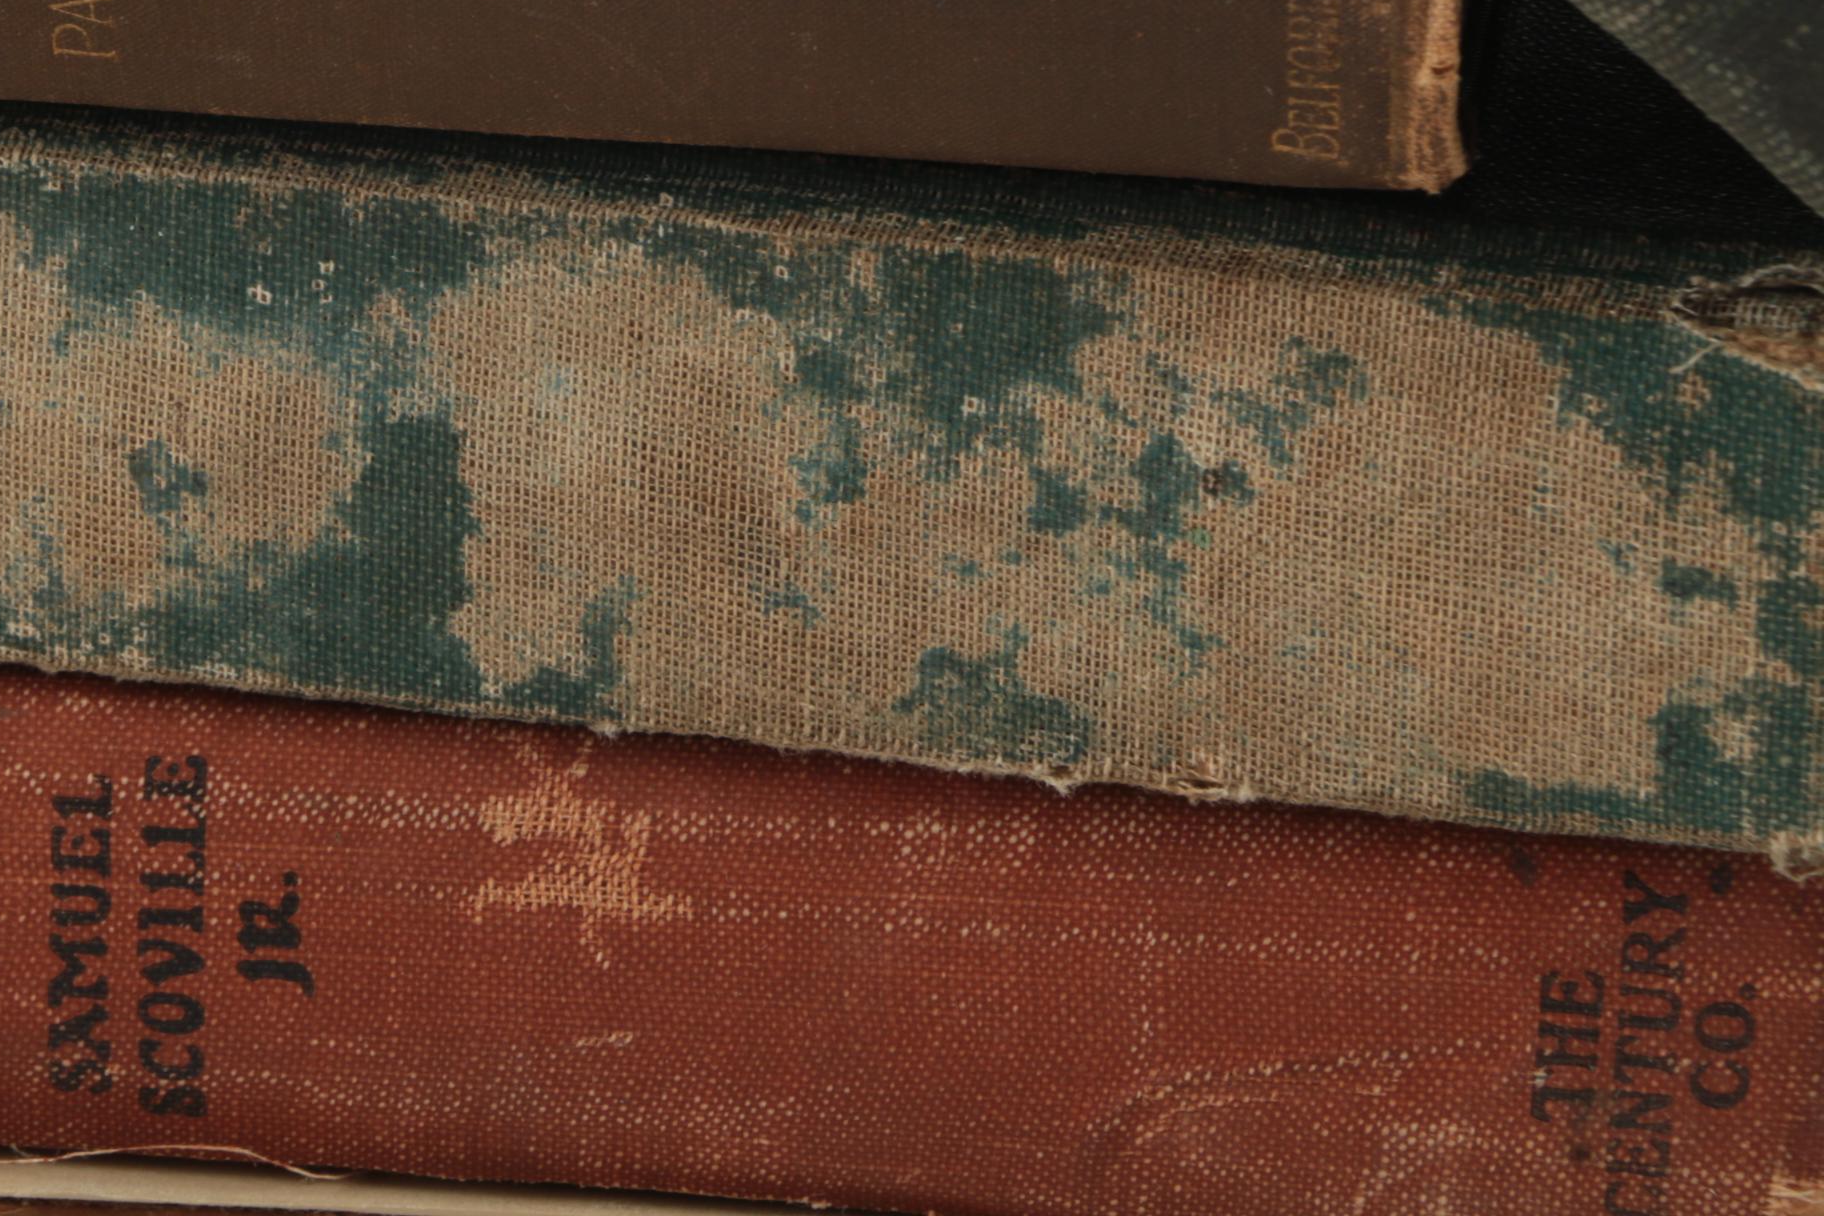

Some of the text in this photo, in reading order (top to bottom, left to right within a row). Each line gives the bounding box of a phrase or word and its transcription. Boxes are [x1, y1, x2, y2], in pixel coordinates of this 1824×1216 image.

[47, 773, 113, 1095] SAMUEL
[136, 754, 208, 1119] SCOVILLE
[235, 869, 316, 999] JR.
[1529, 969, 1607, 1124] THE
[1688, 982, 1760, 1111] CO.
